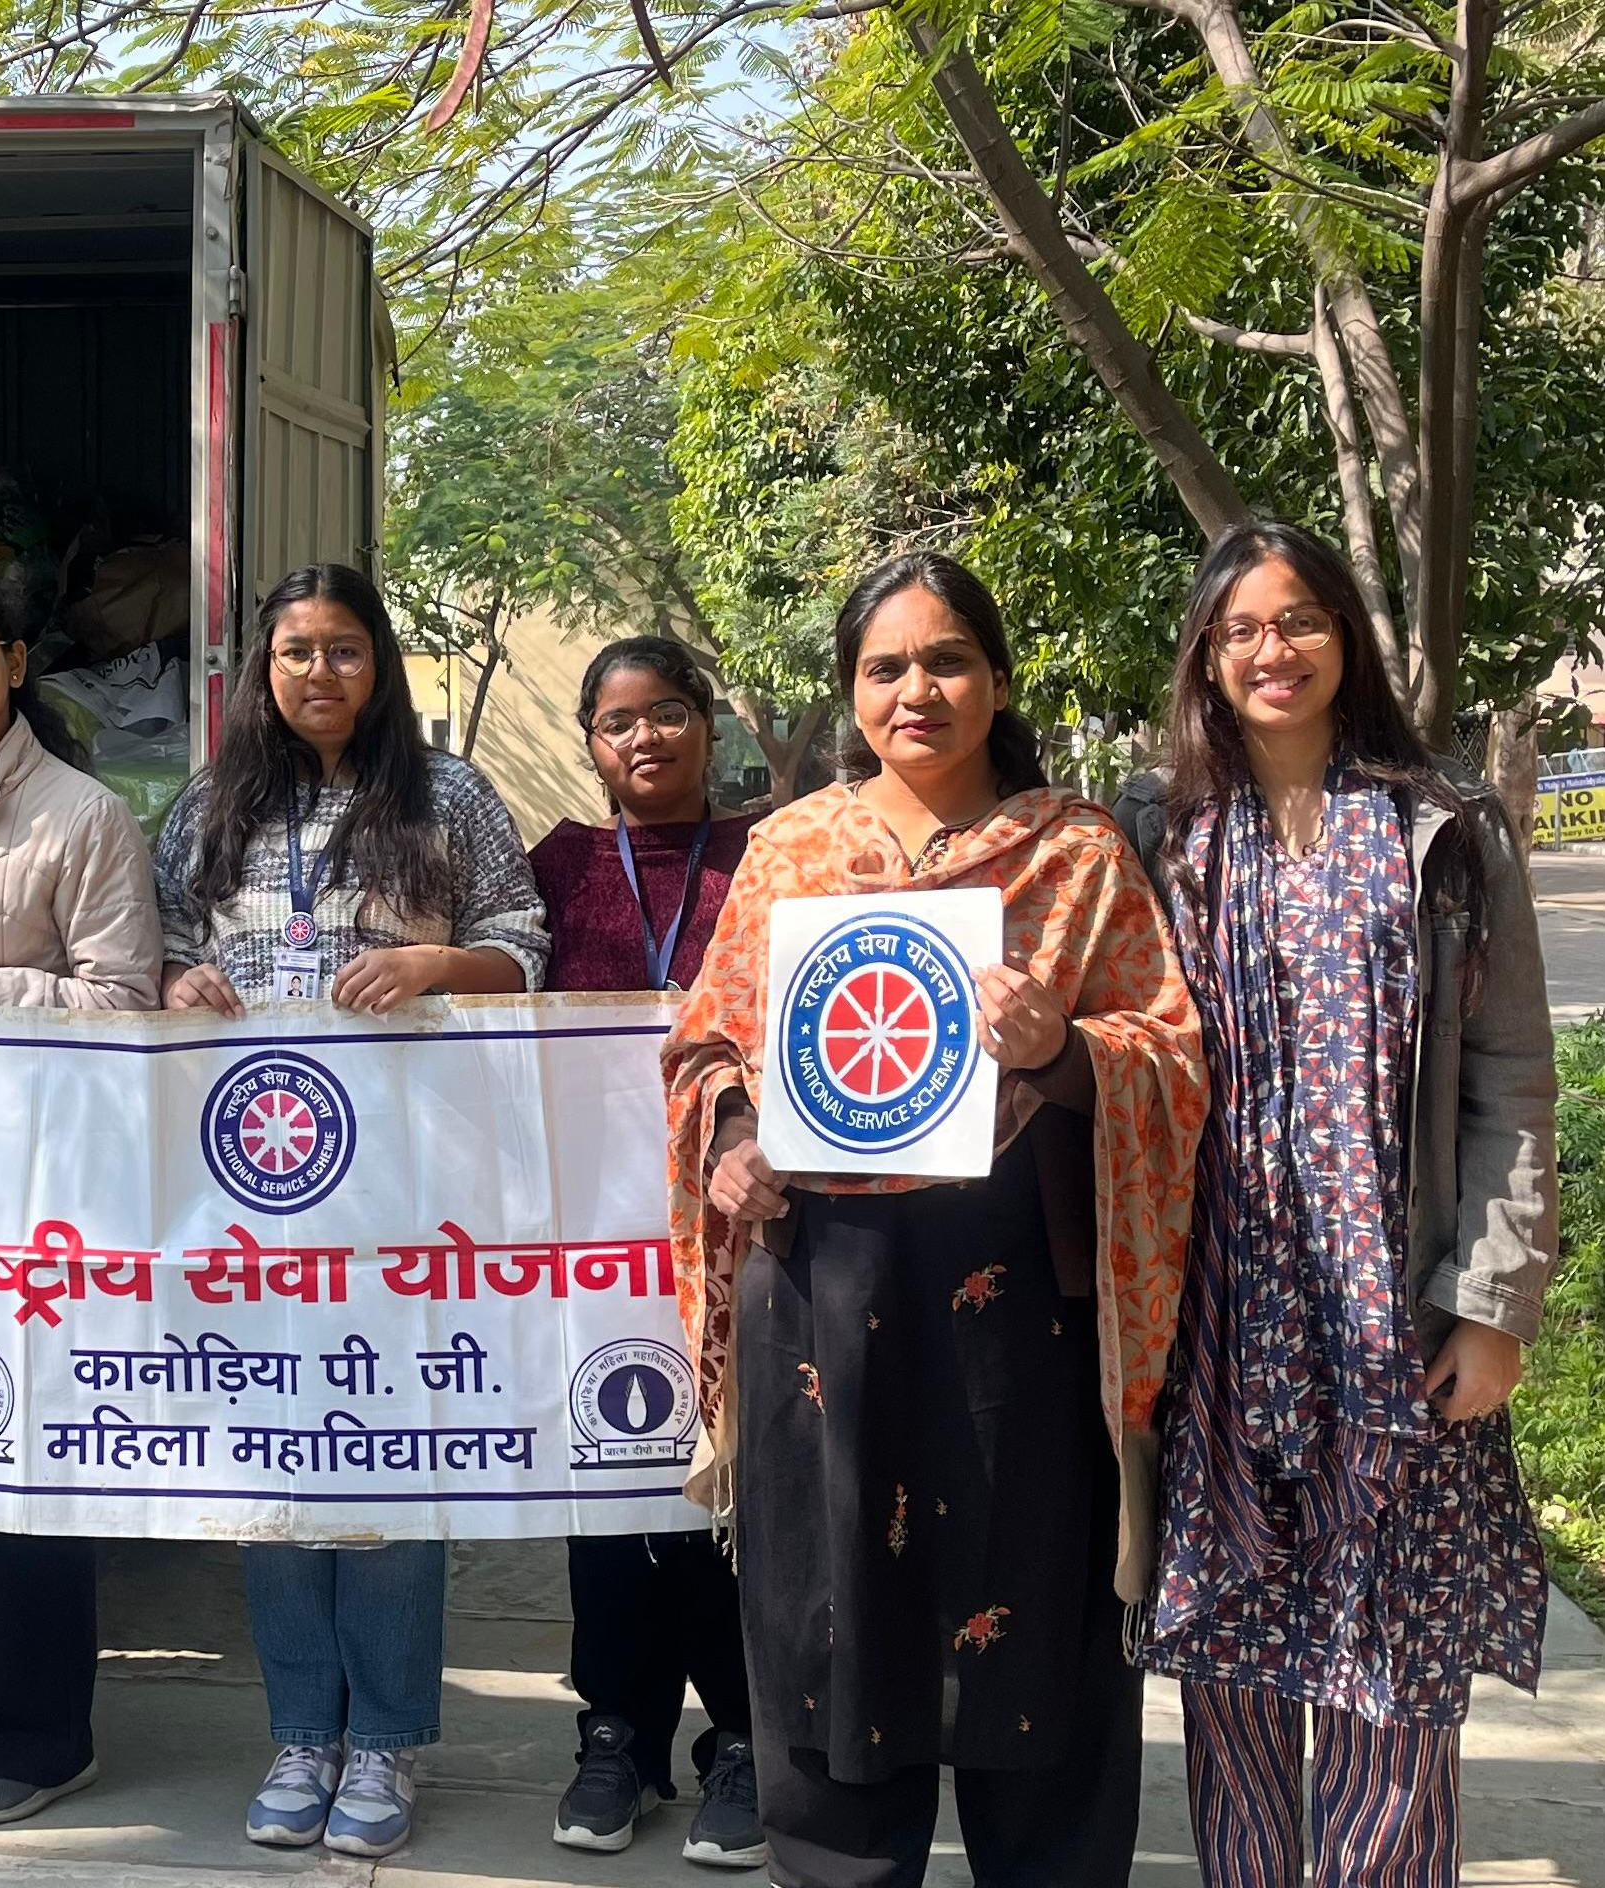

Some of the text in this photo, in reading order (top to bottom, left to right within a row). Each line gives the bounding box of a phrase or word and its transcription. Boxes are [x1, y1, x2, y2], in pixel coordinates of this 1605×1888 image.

[1533, 809, 1605, 830] ARKI
[1560, 791, 1593, 807] NO
[799, 928, 958, 1008] राष्ट्रीय सेवा योजना
[223, 1068, 333, 1120] राष्ट्रीय सेवा योजना
[798, 1047, 959, 1130] NATIONAL SERVICE SCHEME
[221, 1131, 337, 1195] NATIONAL SERVICE SCHEME
[182, 1223, 354, 1303] सेवा
[377, 1220, 677, 1300] योजना
[70, 1332, 502, 1405] कानोड़िया पी. जी.
[43, 1404, 537, 1476] महिला महाविद्यालय
